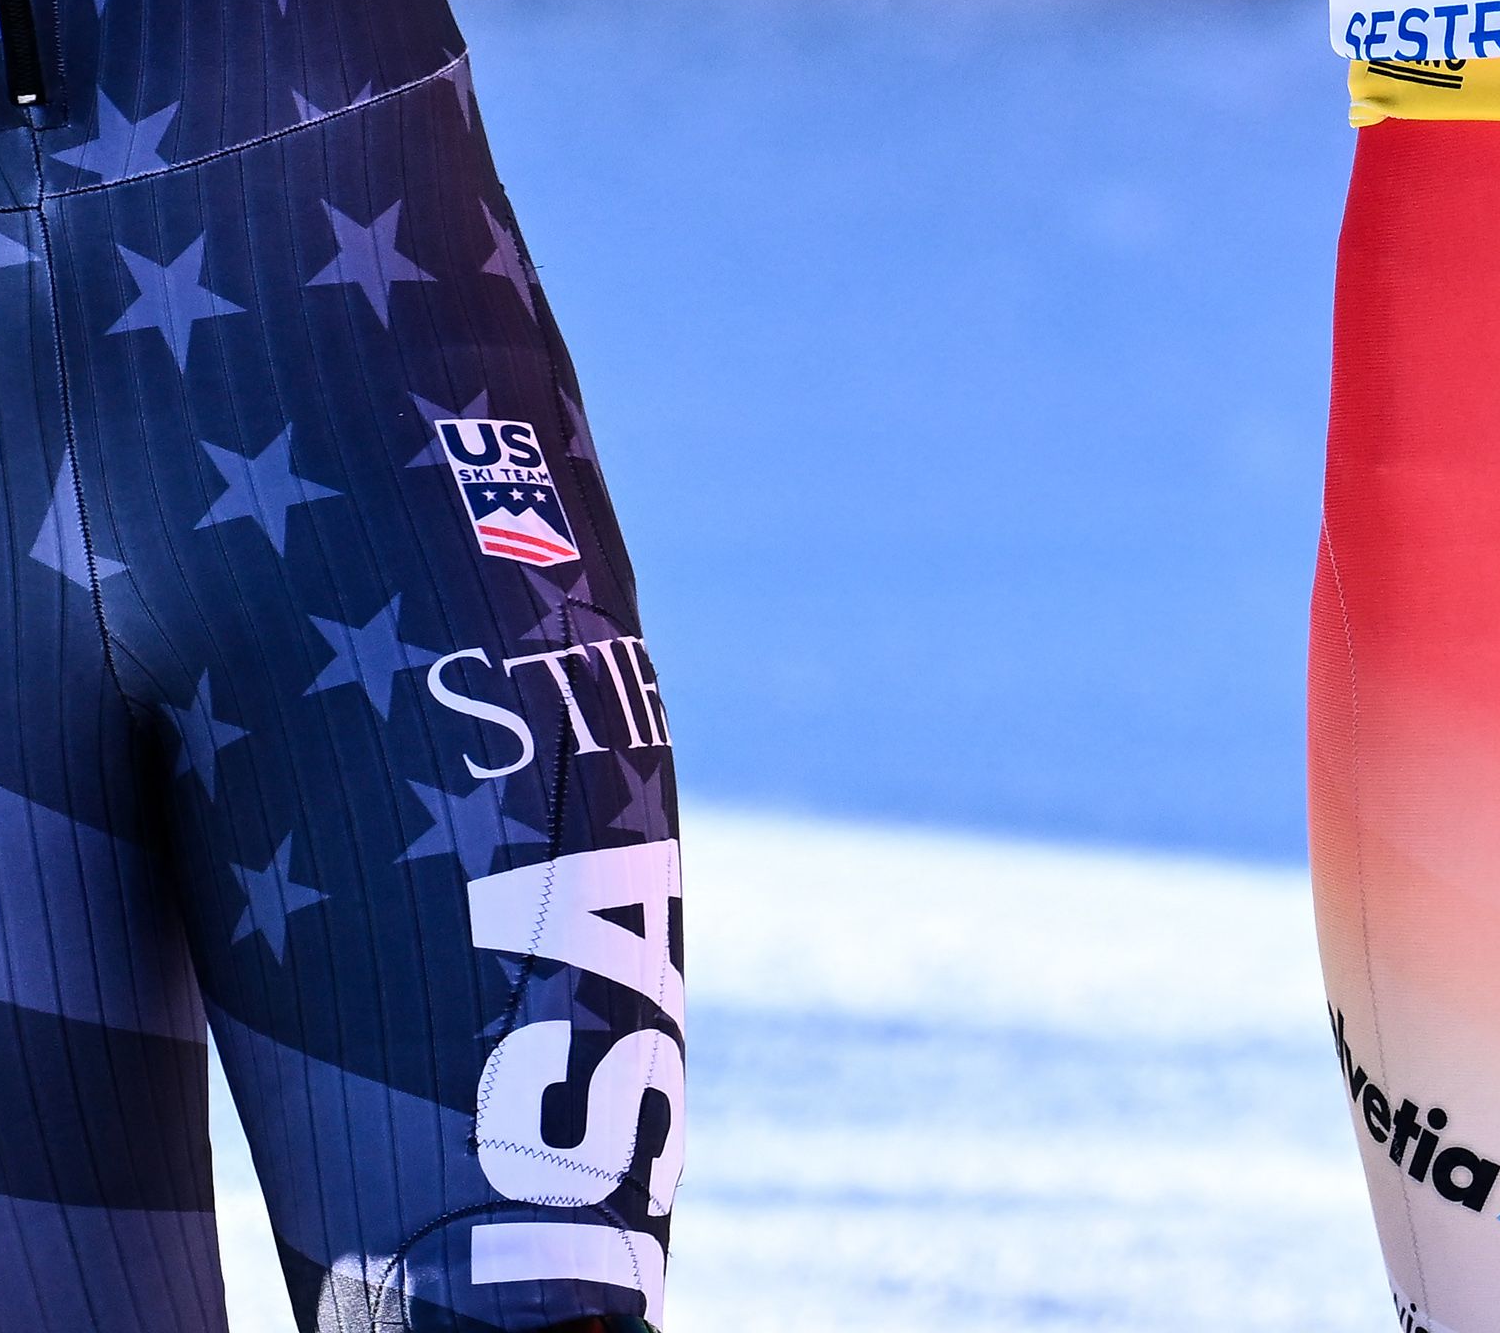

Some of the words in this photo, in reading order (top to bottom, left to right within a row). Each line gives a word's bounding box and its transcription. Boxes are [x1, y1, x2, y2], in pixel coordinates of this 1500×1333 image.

[440, 418, 543, 468] US
[458, 467, 495, 483] SKI
[499, 467, 552, 485] TEAM
[1328, 1001, 1500, 1213] lvetia
